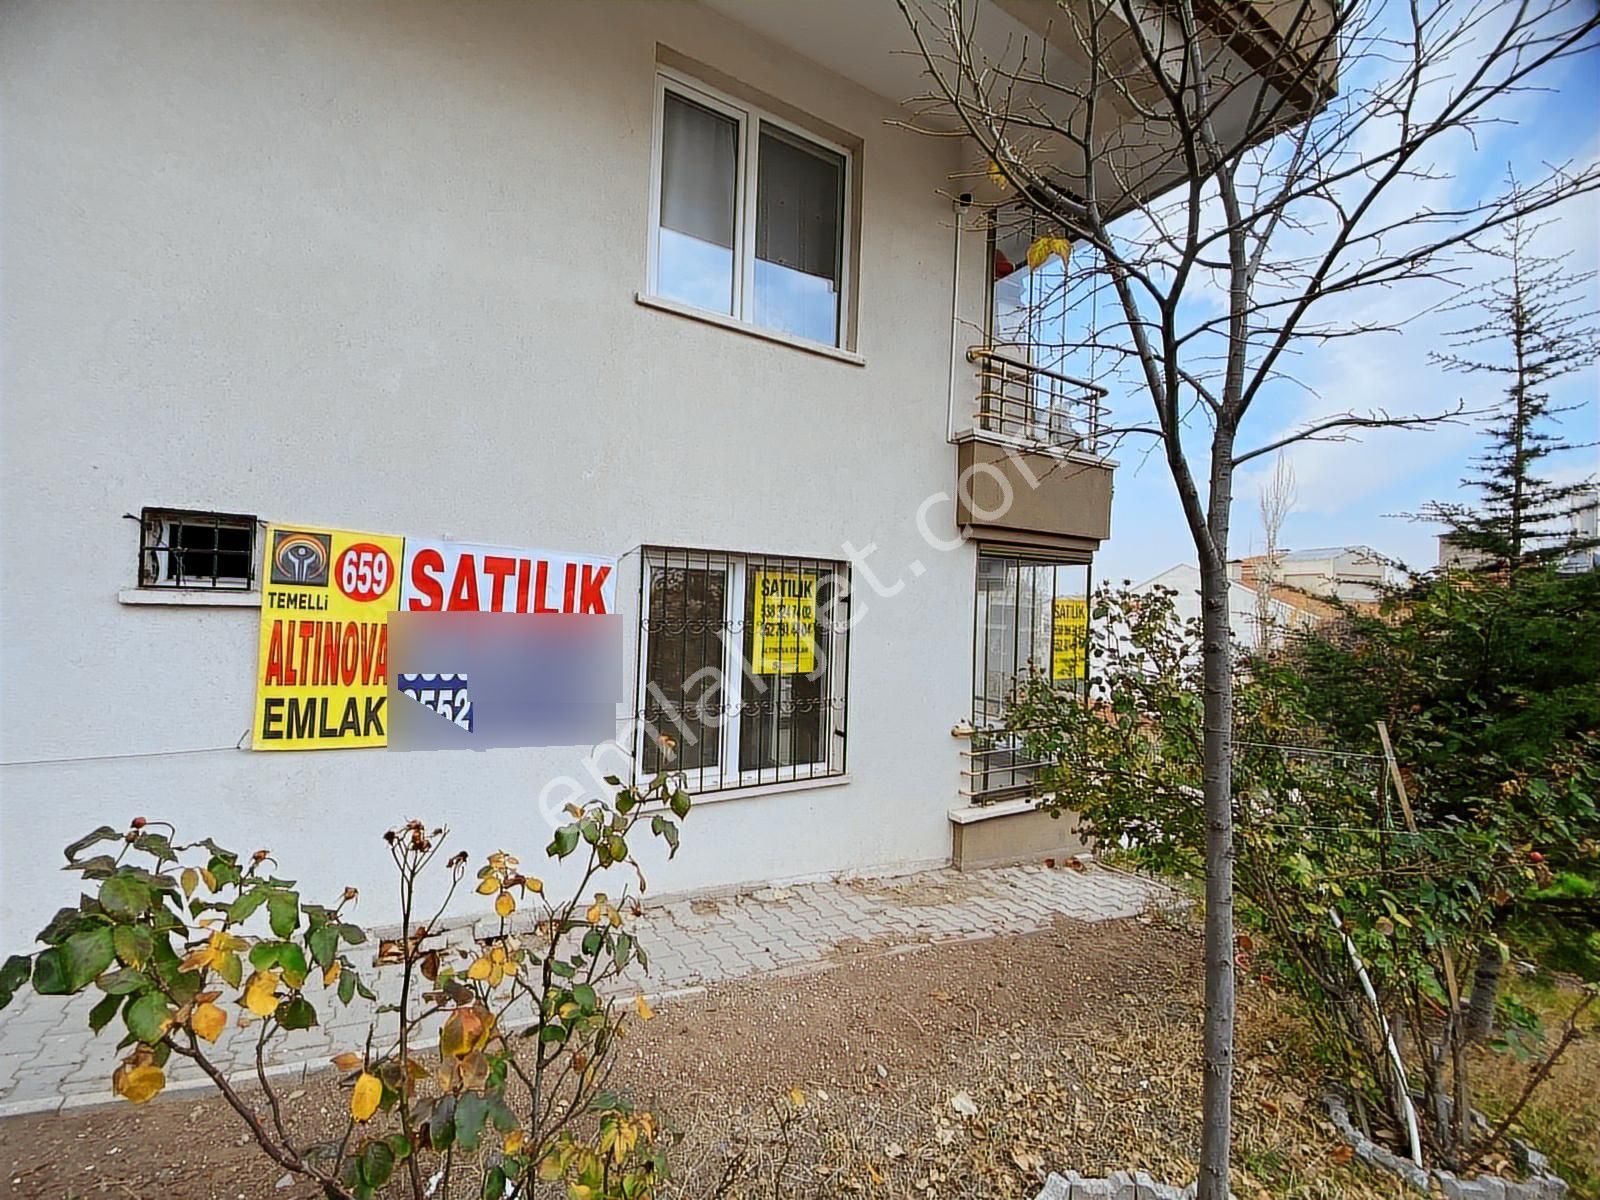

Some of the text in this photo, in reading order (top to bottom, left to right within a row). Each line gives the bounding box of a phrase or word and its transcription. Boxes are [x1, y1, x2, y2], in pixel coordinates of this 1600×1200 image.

[341, 550, 388, 595] 659
[408, 547, 613, 616] SATILIK
[761, 578, 813, 599] SATILIK
[265, 618, 388, 687] ALTINOVA
[263, 696, 388, 740] EMLAK
